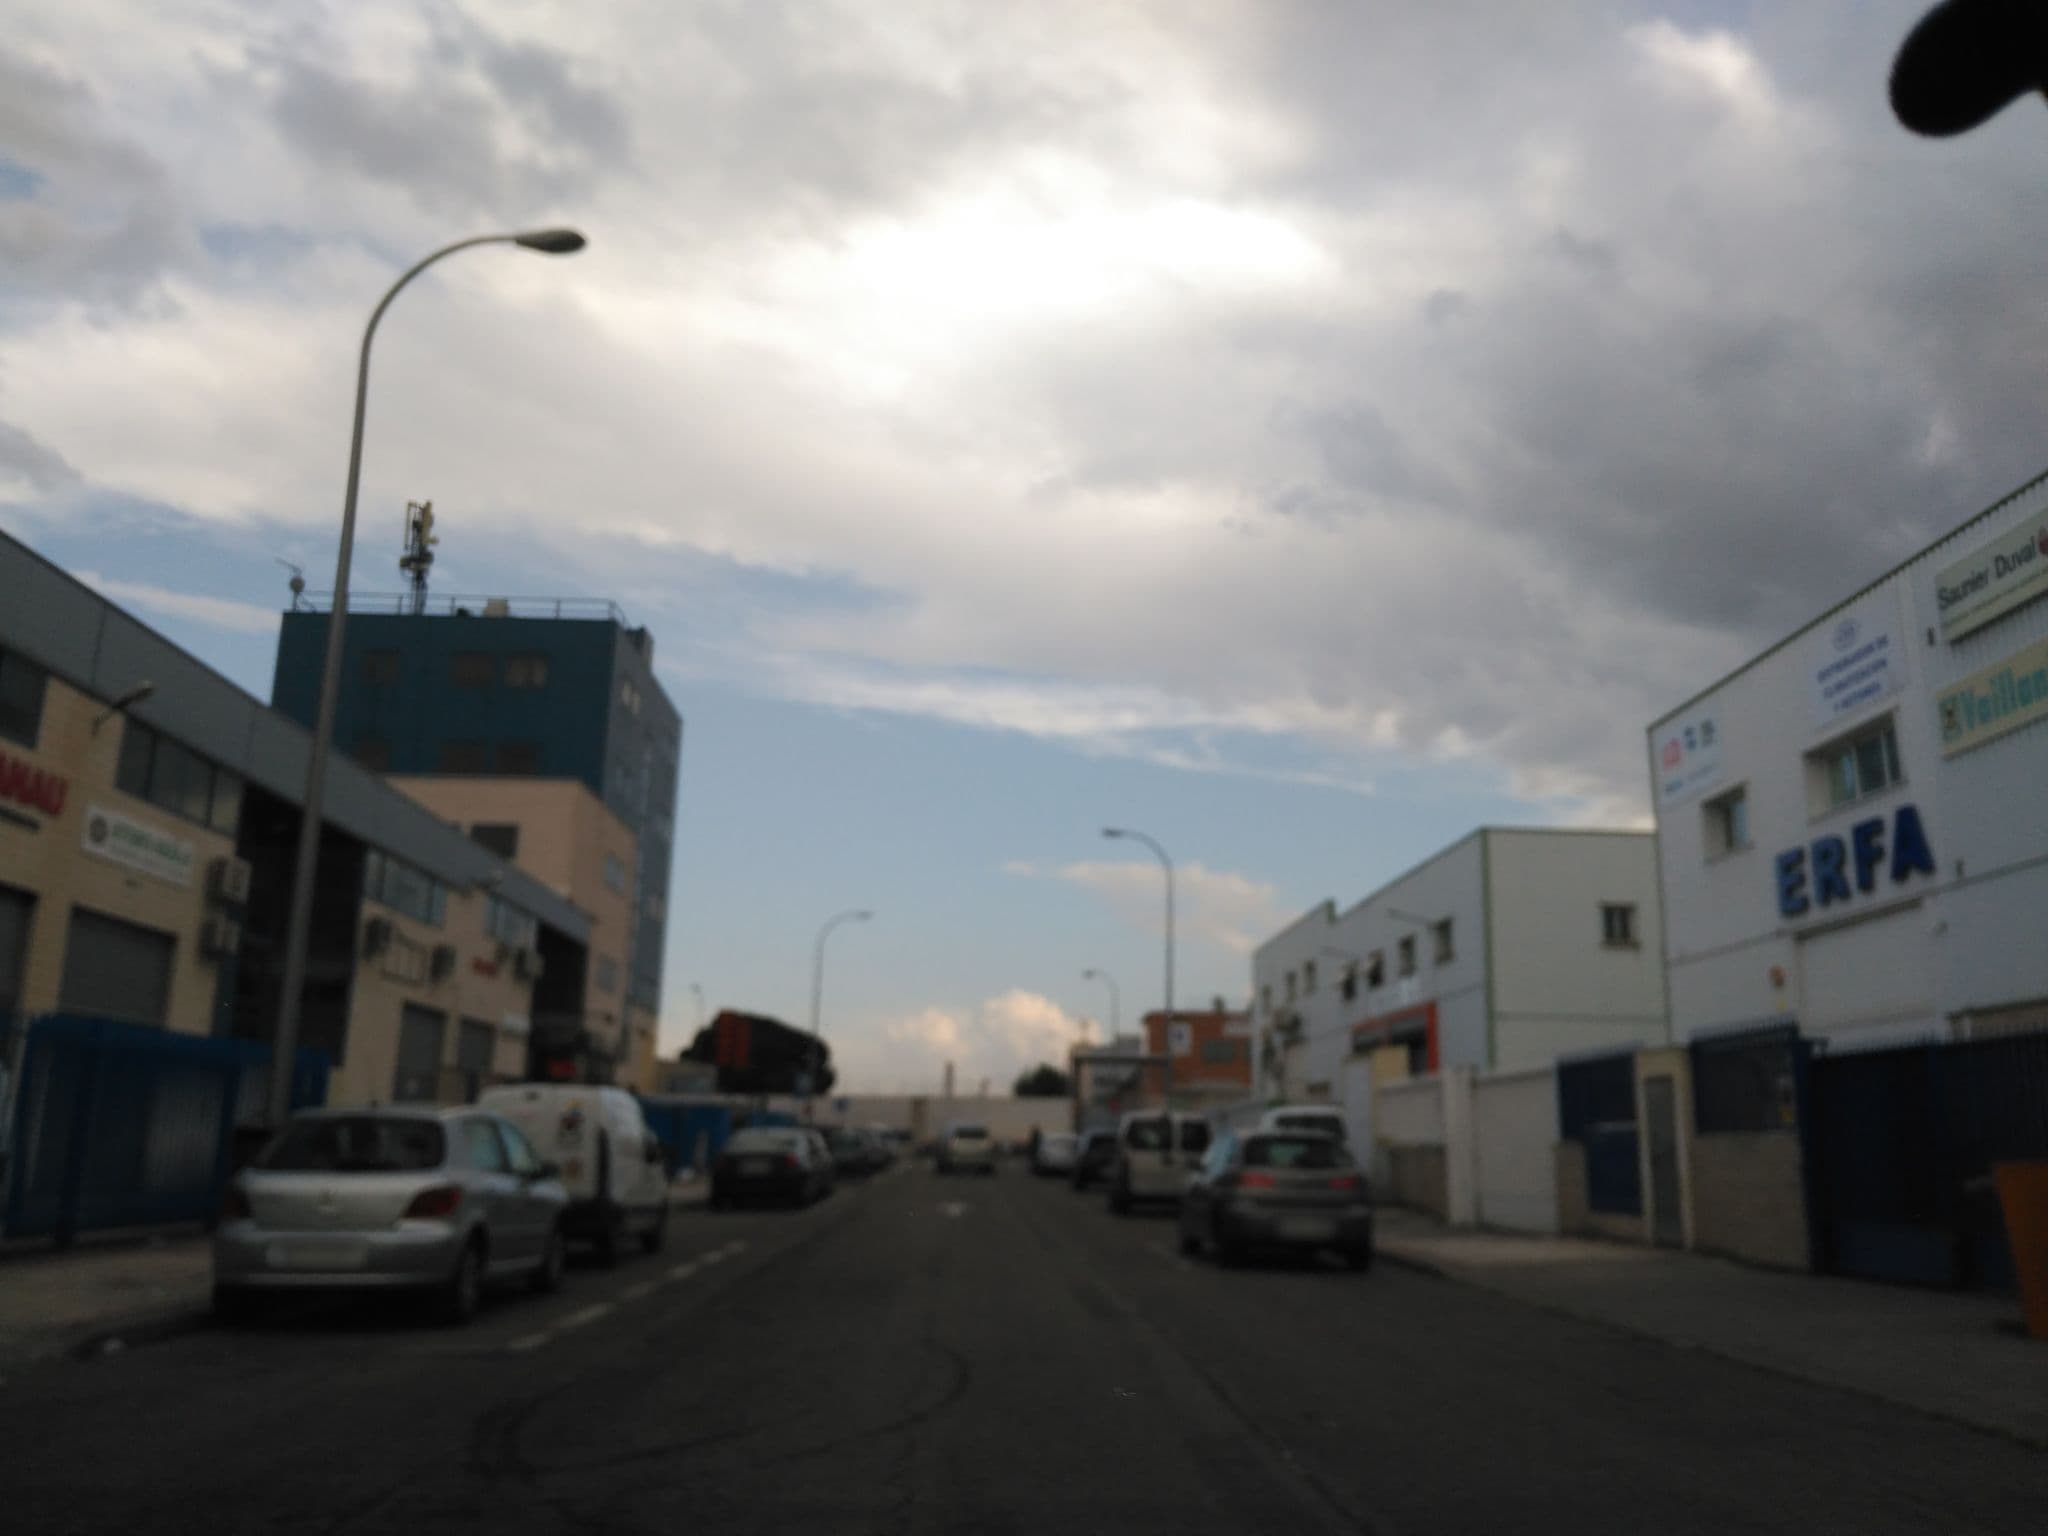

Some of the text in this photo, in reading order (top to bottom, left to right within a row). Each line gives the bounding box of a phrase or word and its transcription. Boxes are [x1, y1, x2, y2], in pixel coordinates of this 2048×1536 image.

[1938, 536, 2038, 611] Saunier Duval
[1775, 803, 1936, 917] ERFA
